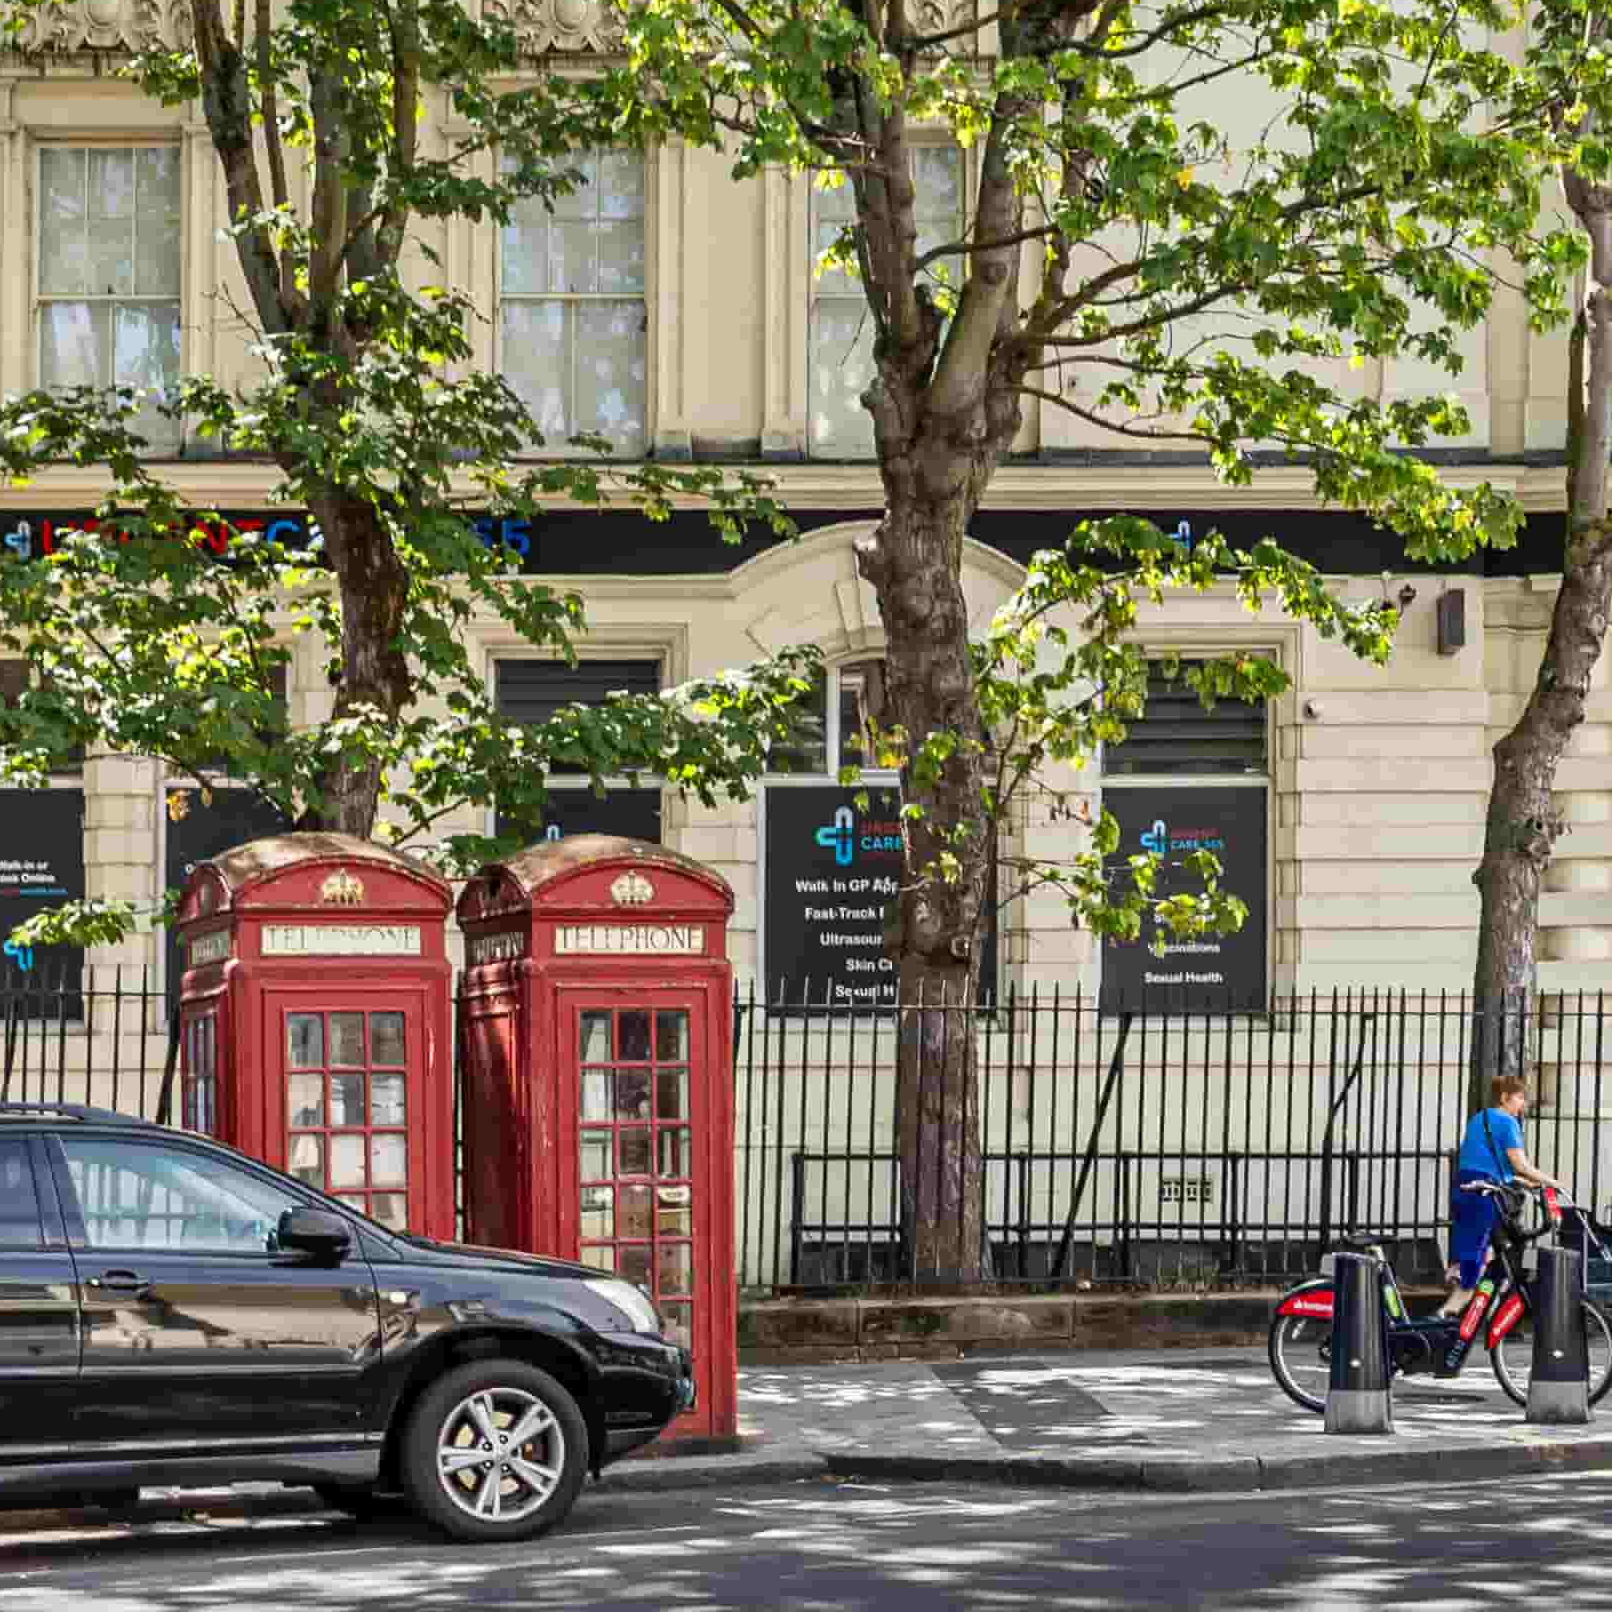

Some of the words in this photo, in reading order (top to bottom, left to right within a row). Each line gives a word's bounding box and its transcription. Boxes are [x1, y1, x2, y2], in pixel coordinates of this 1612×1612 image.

[795, 880, 829, 892] Walk
[834, 880, 847, 892] In
[849, 879, 871, 892] GP
[562, 926, 703, 951] TELEPHONE
[845, 958, 876, 972] Skin
[1144, 971, 1183, 984] Sexual
[1186, 971, 1223, 984] Health
